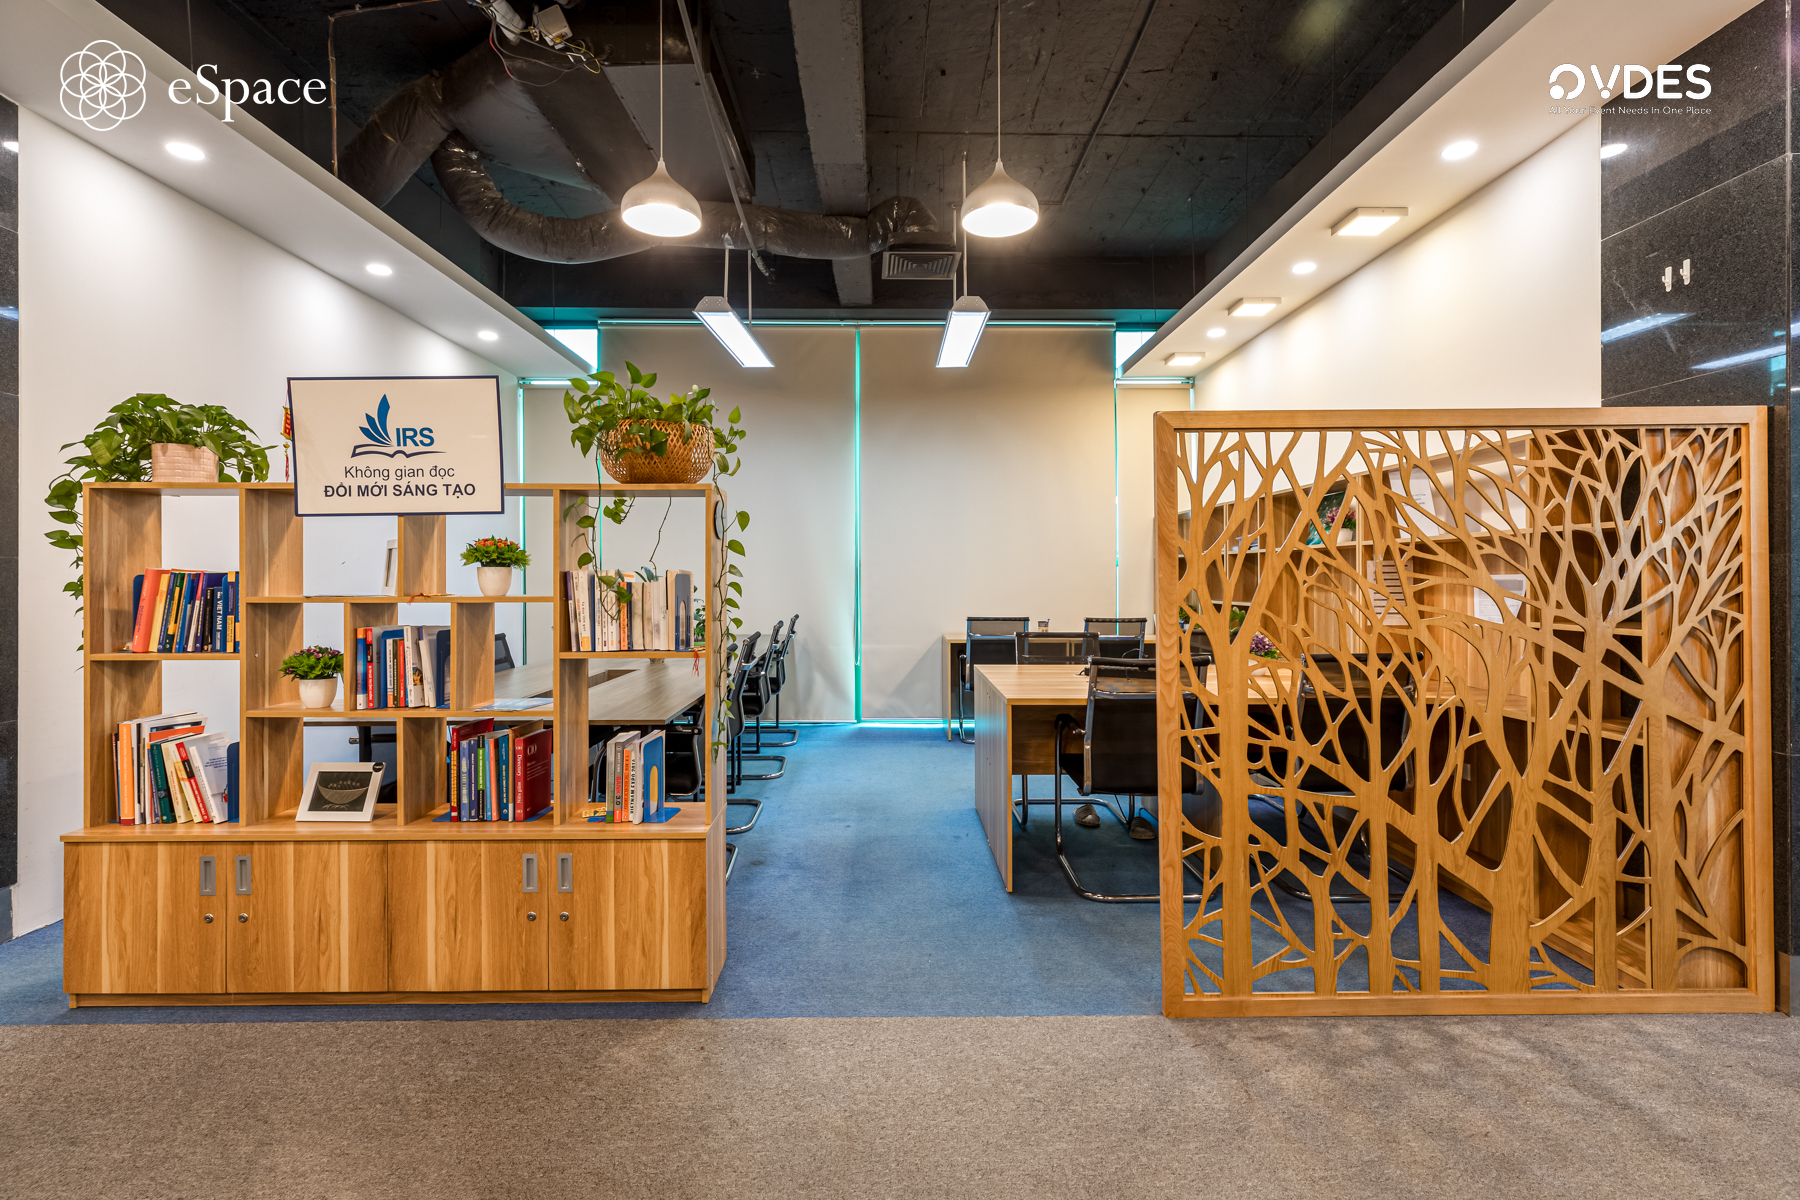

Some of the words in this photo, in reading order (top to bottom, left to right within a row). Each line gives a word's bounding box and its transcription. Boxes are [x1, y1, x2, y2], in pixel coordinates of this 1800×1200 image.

[396, 427, 434, 447] IRS
[344, 466, 390, 481] Không
[394, 466, 424, 481] gian
[429, 465, 455, 480] đọc
[324, 482, 352, 498] ĐỔI
[357, 482, 388, 497] MỚI
[392, 481, 438, 496] SÁNG
[442, 483, 476, 498] TẠO
